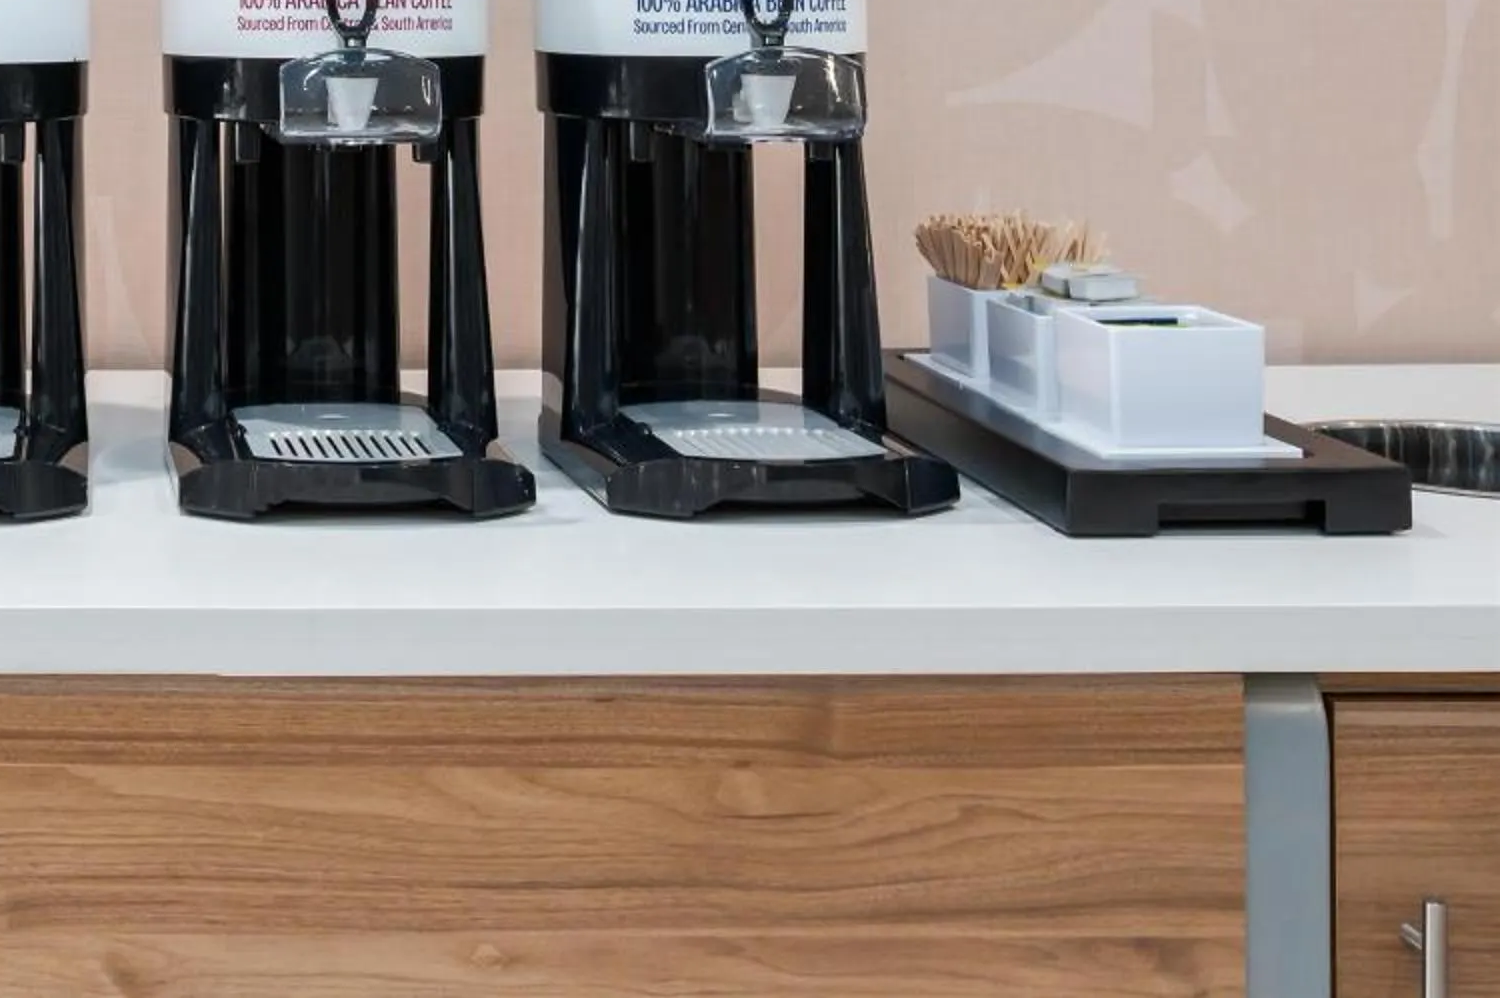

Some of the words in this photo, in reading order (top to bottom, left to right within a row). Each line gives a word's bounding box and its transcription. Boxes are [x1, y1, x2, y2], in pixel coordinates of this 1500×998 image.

[237, 16, 285, 31] Sourced
[381, 15, 415, 31] South
[633, 18, 685, 35] Sourced
